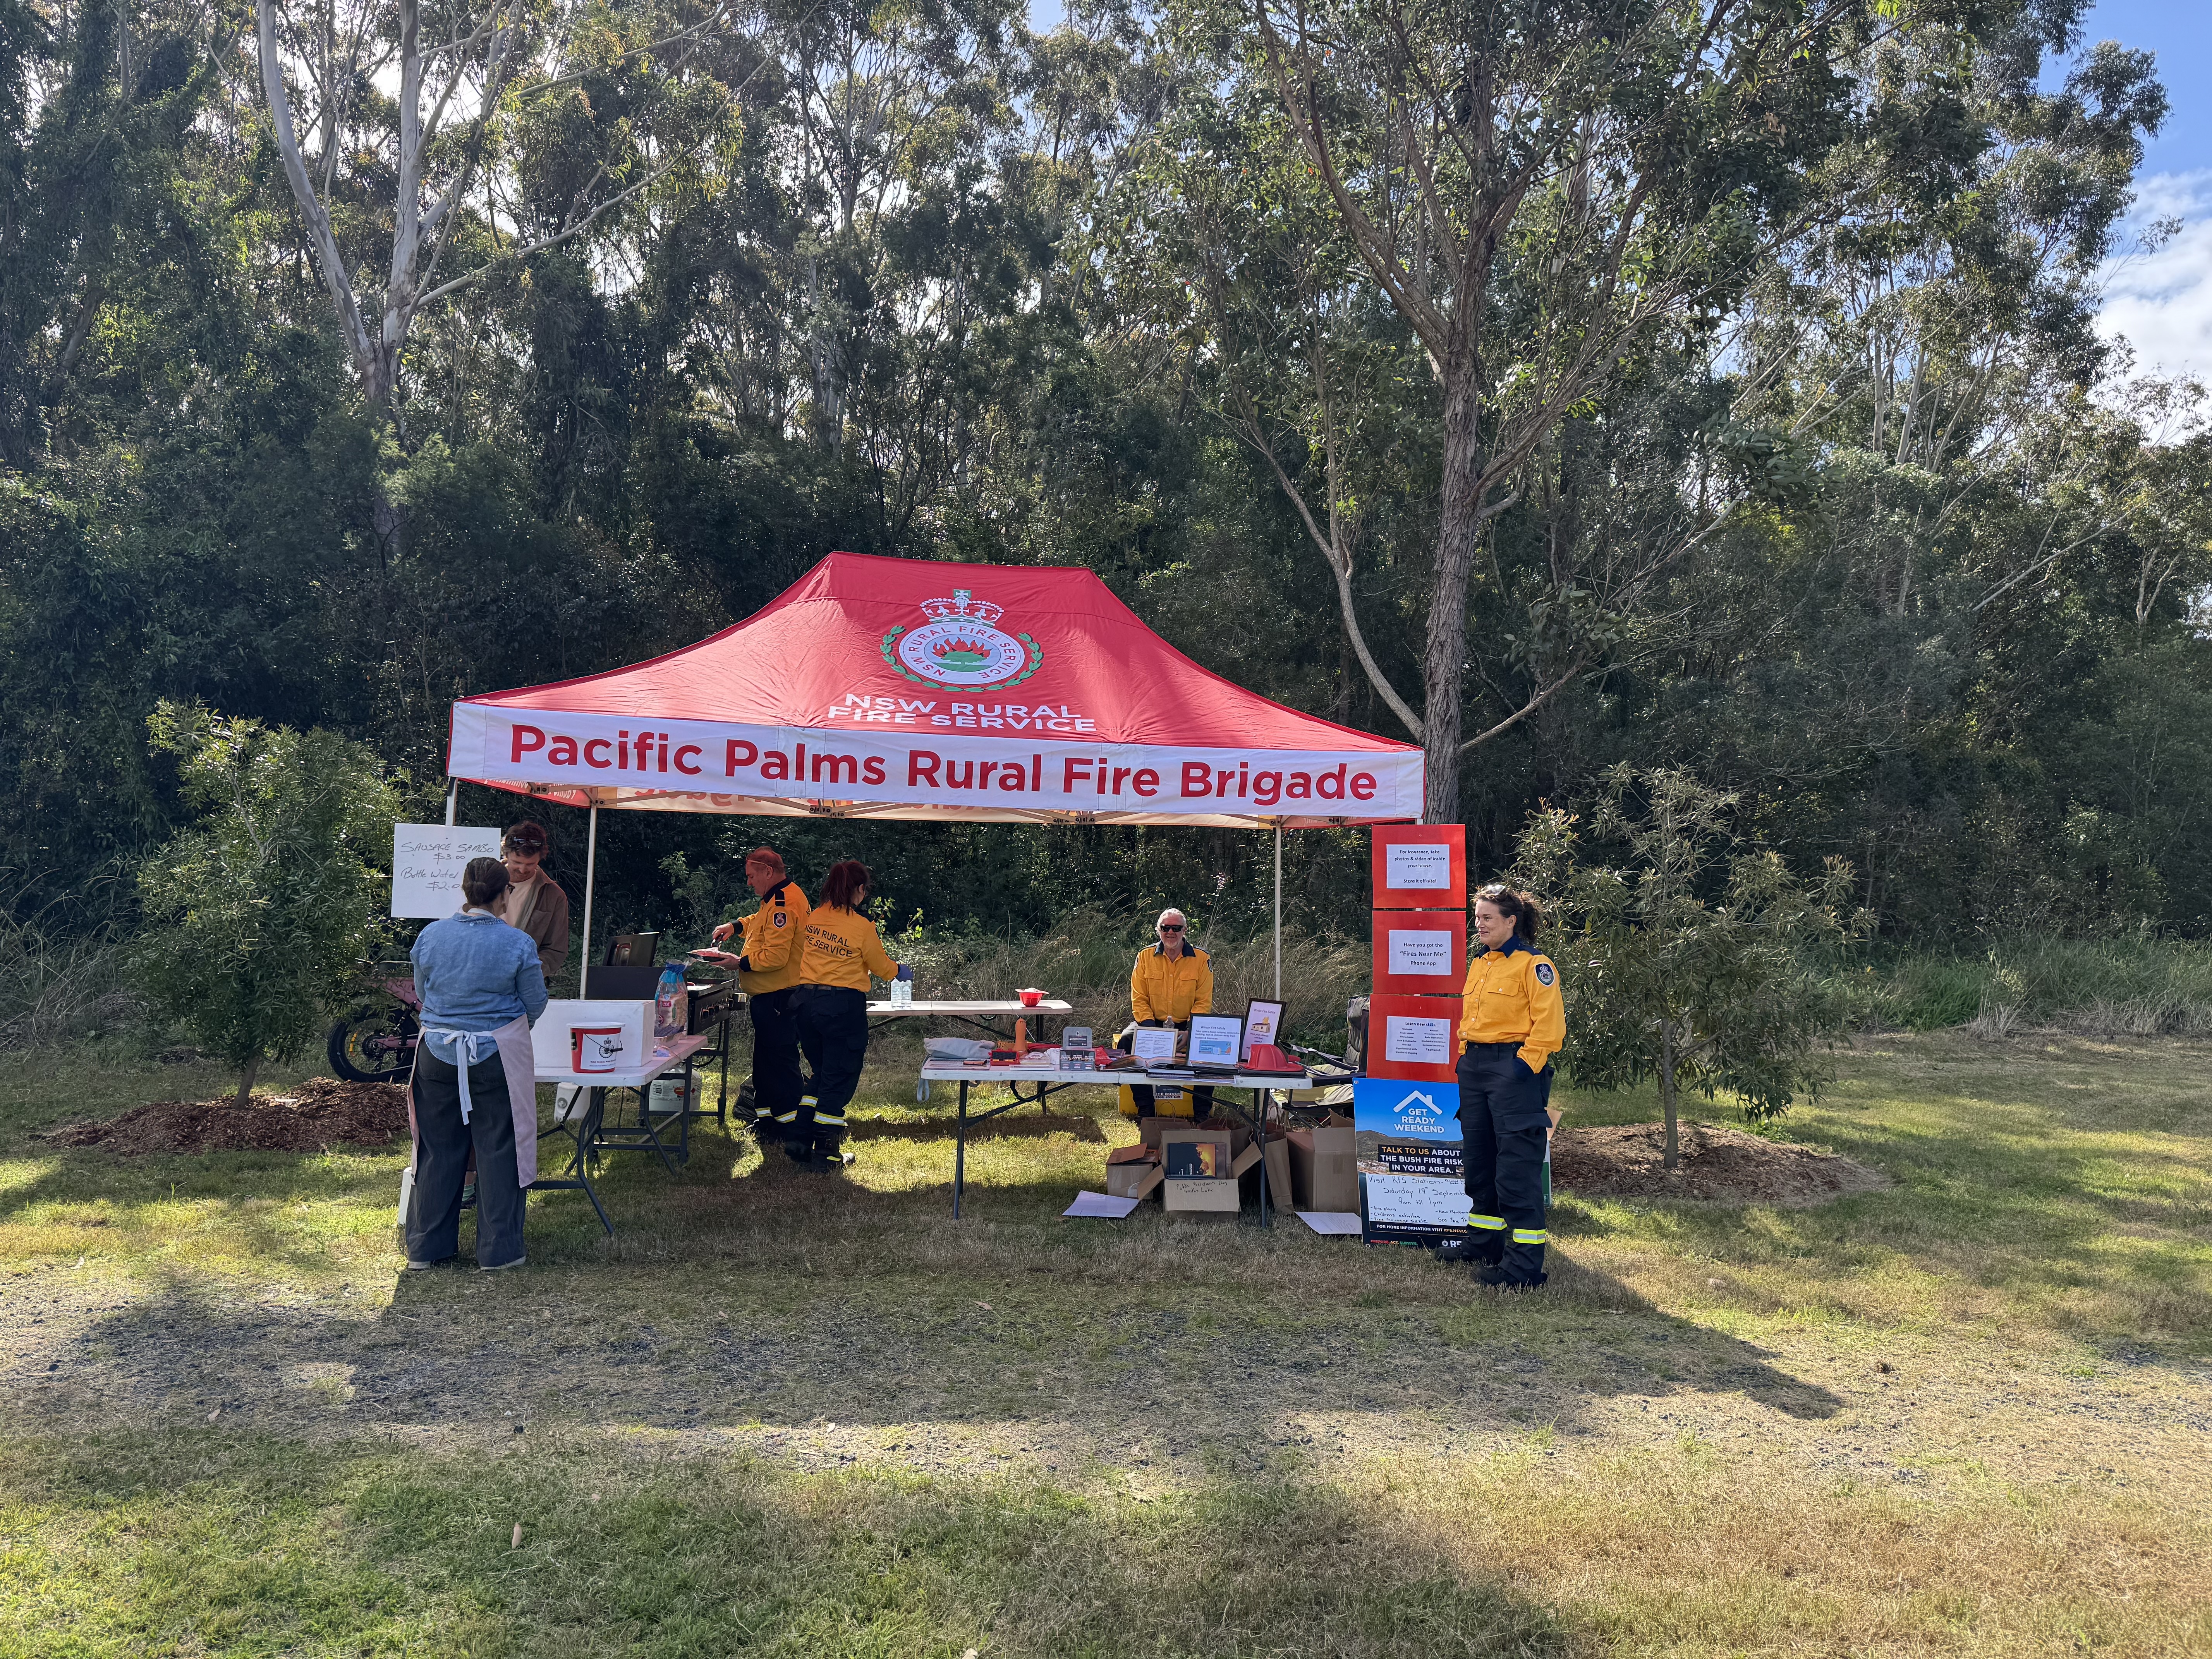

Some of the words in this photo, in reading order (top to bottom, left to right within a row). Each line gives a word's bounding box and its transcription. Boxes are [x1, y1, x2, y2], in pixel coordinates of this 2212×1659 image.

[908, 627, 951, 652] RURAL
[959, 625, 1000, 641] FIRE
[911, 656, 946, 677] NSW
[978, 642, 1016, 679] SERVICE
[845, 693, 937, 713] NSW
[951, 703, 1081, 718] RURAL
[828, 706, 917, 724] FIRE
[931, 715, 1097, 732] SERVICE
[511, 724, 703, 775] Pacific
[725, 739, 886, 785] Palms
[908, 750, 1042, 792] Rural
[1063, 757, 1160, 797] Fire
[1181, 761, 1377, 806] Brigade
[400, 842, 452, 852] SAUSAGE
[457, 843, 494, 852] SAMBO
[433, 852, 465, 865] $3.00
[400, 867, 426, 879] Bottle
[431, 869, 459, 879] Water
[425, 881, 460, 891] $2.0
[805, 925, 820, 935] NSW
[821, 930, 849, 948] RURAL
[814, 939, 852, 957] SERVICE
[1408, 1108, 1428, 1116] GET
[1394, 1123, 1444, 1133] WEEKEND
[1401, 1116, 1435, 1125] READY
[1383, 1187, 1413, 1199] Saturday
[1432, 1188, 1465, 1198] Septemb
